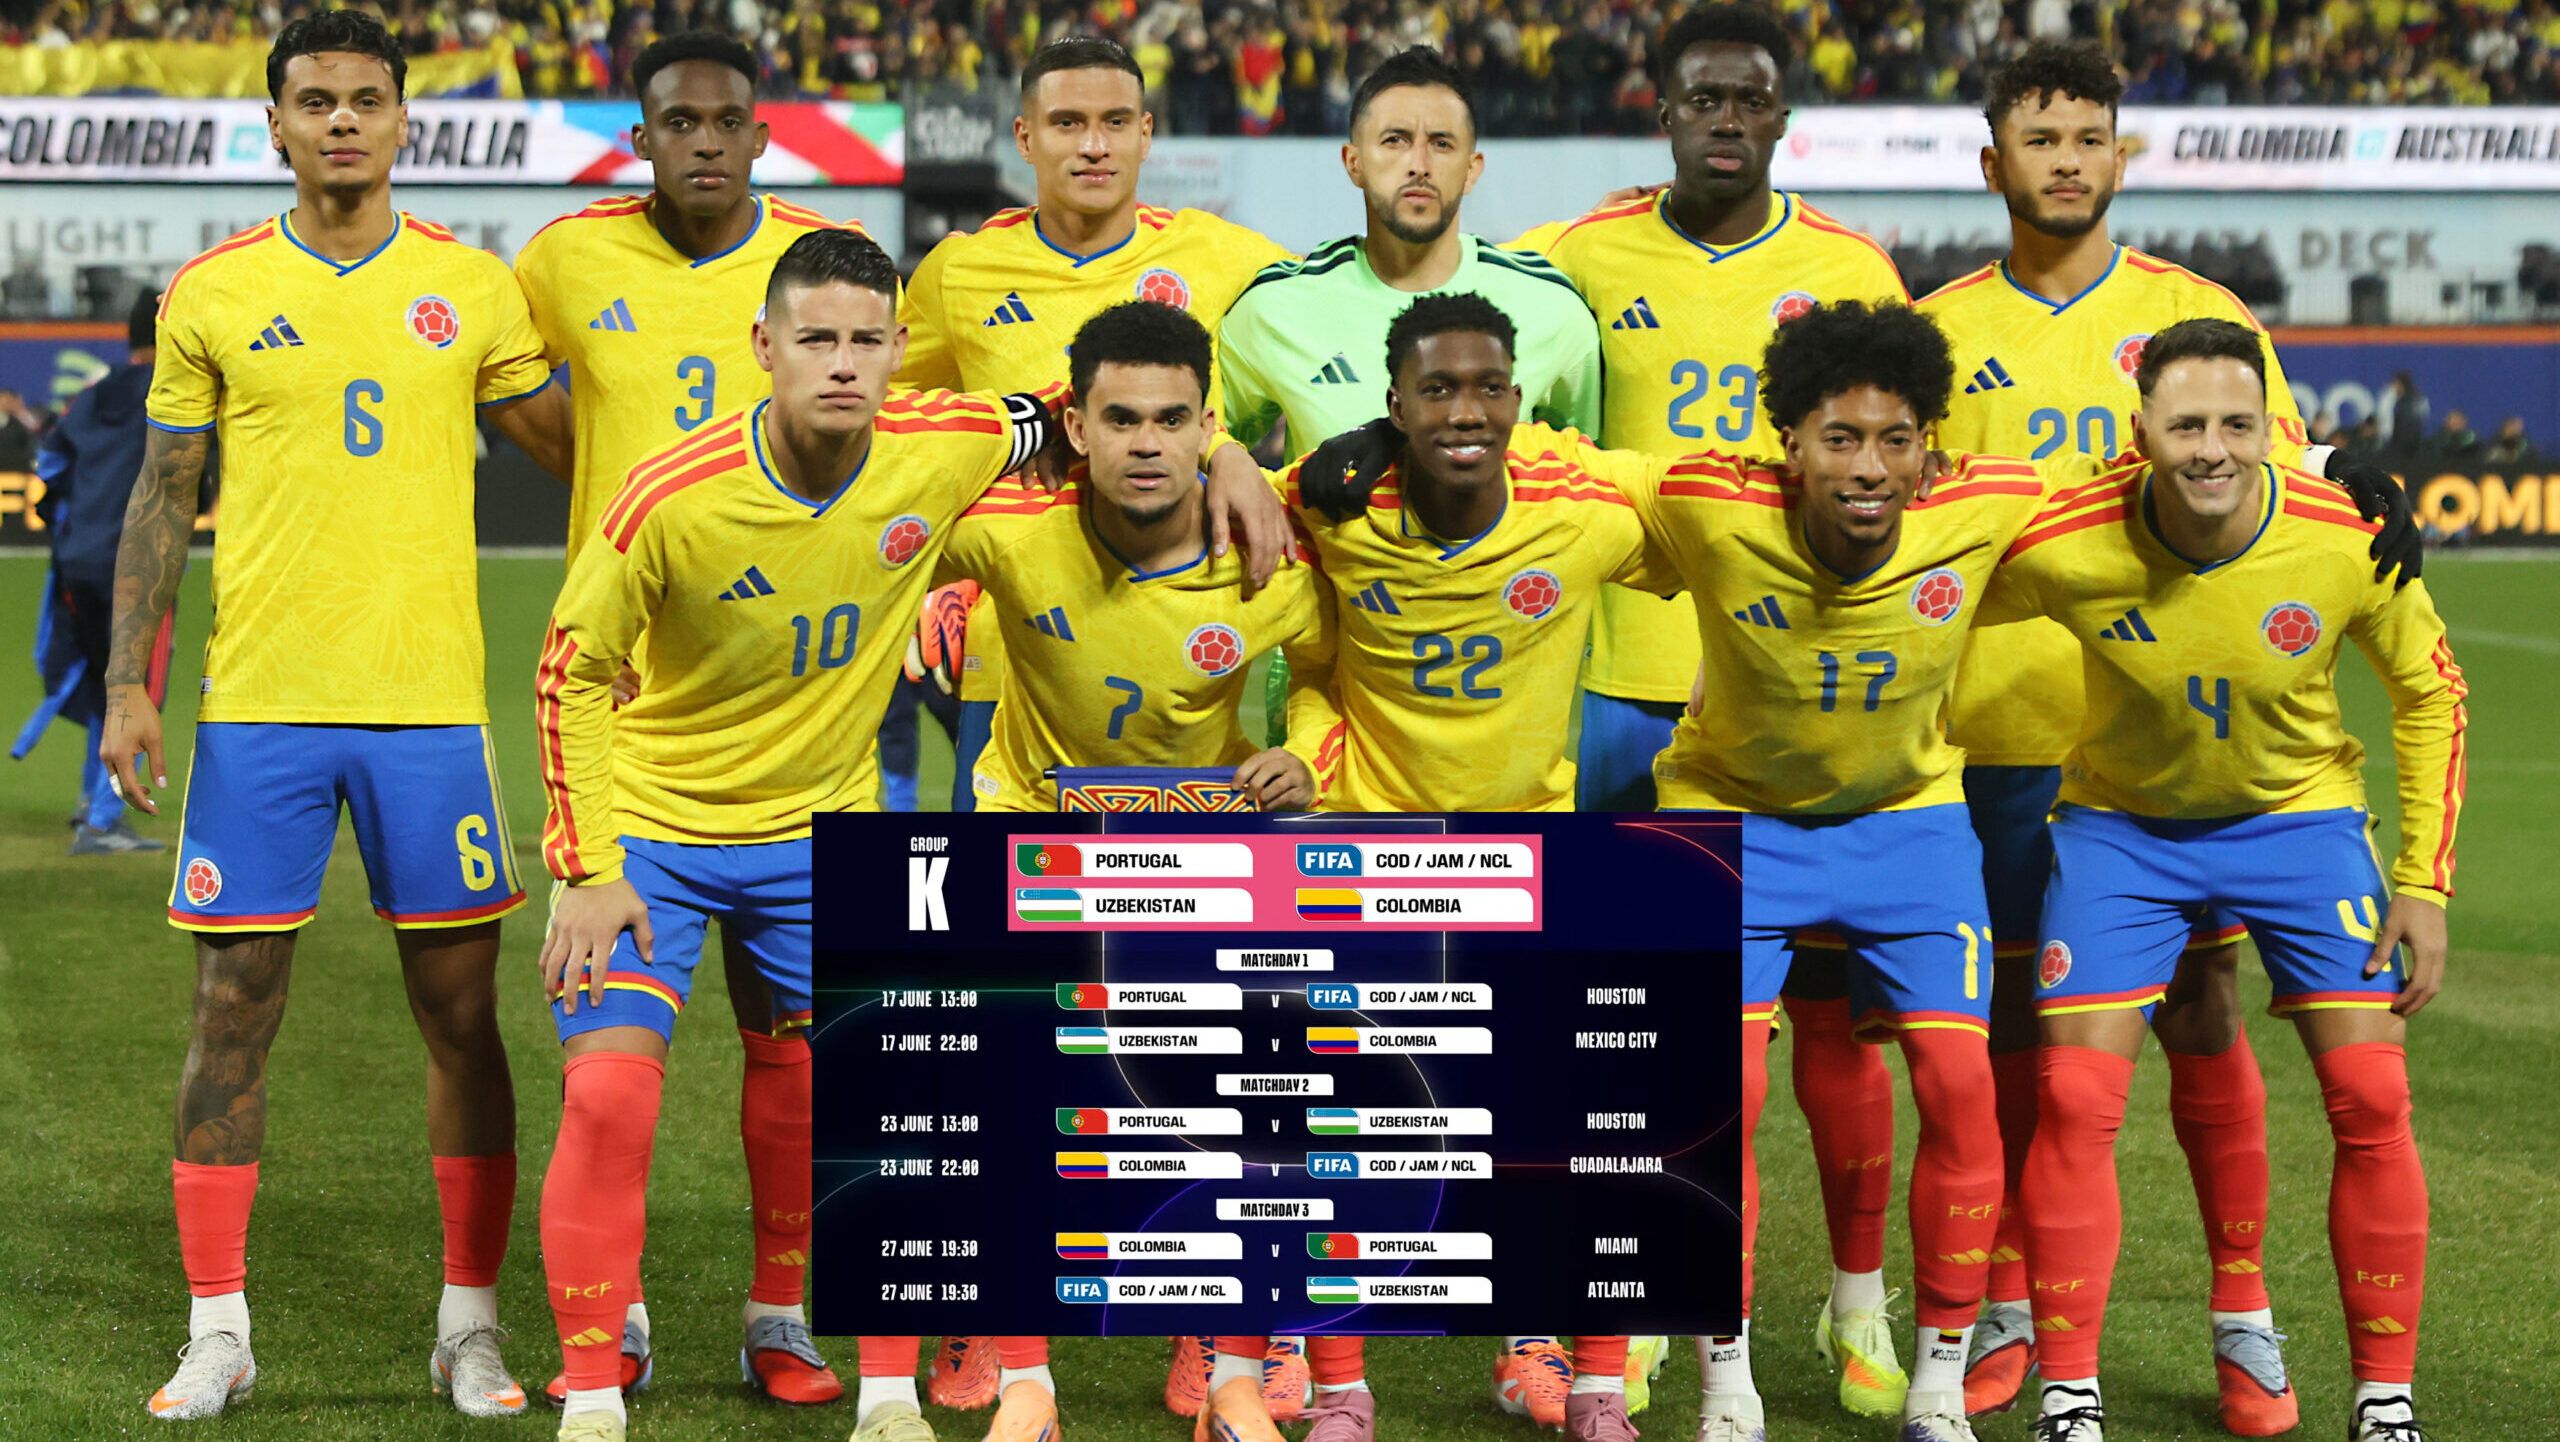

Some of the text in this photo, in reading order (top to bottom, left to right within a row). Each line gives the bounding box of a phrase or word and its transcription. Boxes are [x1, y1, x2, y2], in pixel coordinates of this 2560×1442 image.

[0, 118, 214, 167] OLOMBIA
[2174, 124, 2348, 165] COLOMBIA
[2394, 124, 2560, 165] AUSTRALI
[345, 379, 384, 457] 6
[675, 356, 715, 432] 3
[1668, 359, 1758, 443] 23
[2028, 407, 2116, 461] 20
[792, 603, 860, 676] 10
[1413, 634, 1502, 699] 22
[1105, 675, 1143, 739] 7
[1819, 651, 1897, 712] 17
[2188, 676, 2229, 739] 4
[456, 814, 496, 892] 6
[1957, 922, 1991, 999] 1
[770, 1208, 810, 1225] FCF
[1948, 1203, 1995, 1220] FCF
[2222, 1219, 2258, 1234] FCF
[564, 1280, 614, 1301] FCF
[2034, 1279, 2086, 1295] FCF
[2355, 1269, 2406, 1289] FCF
